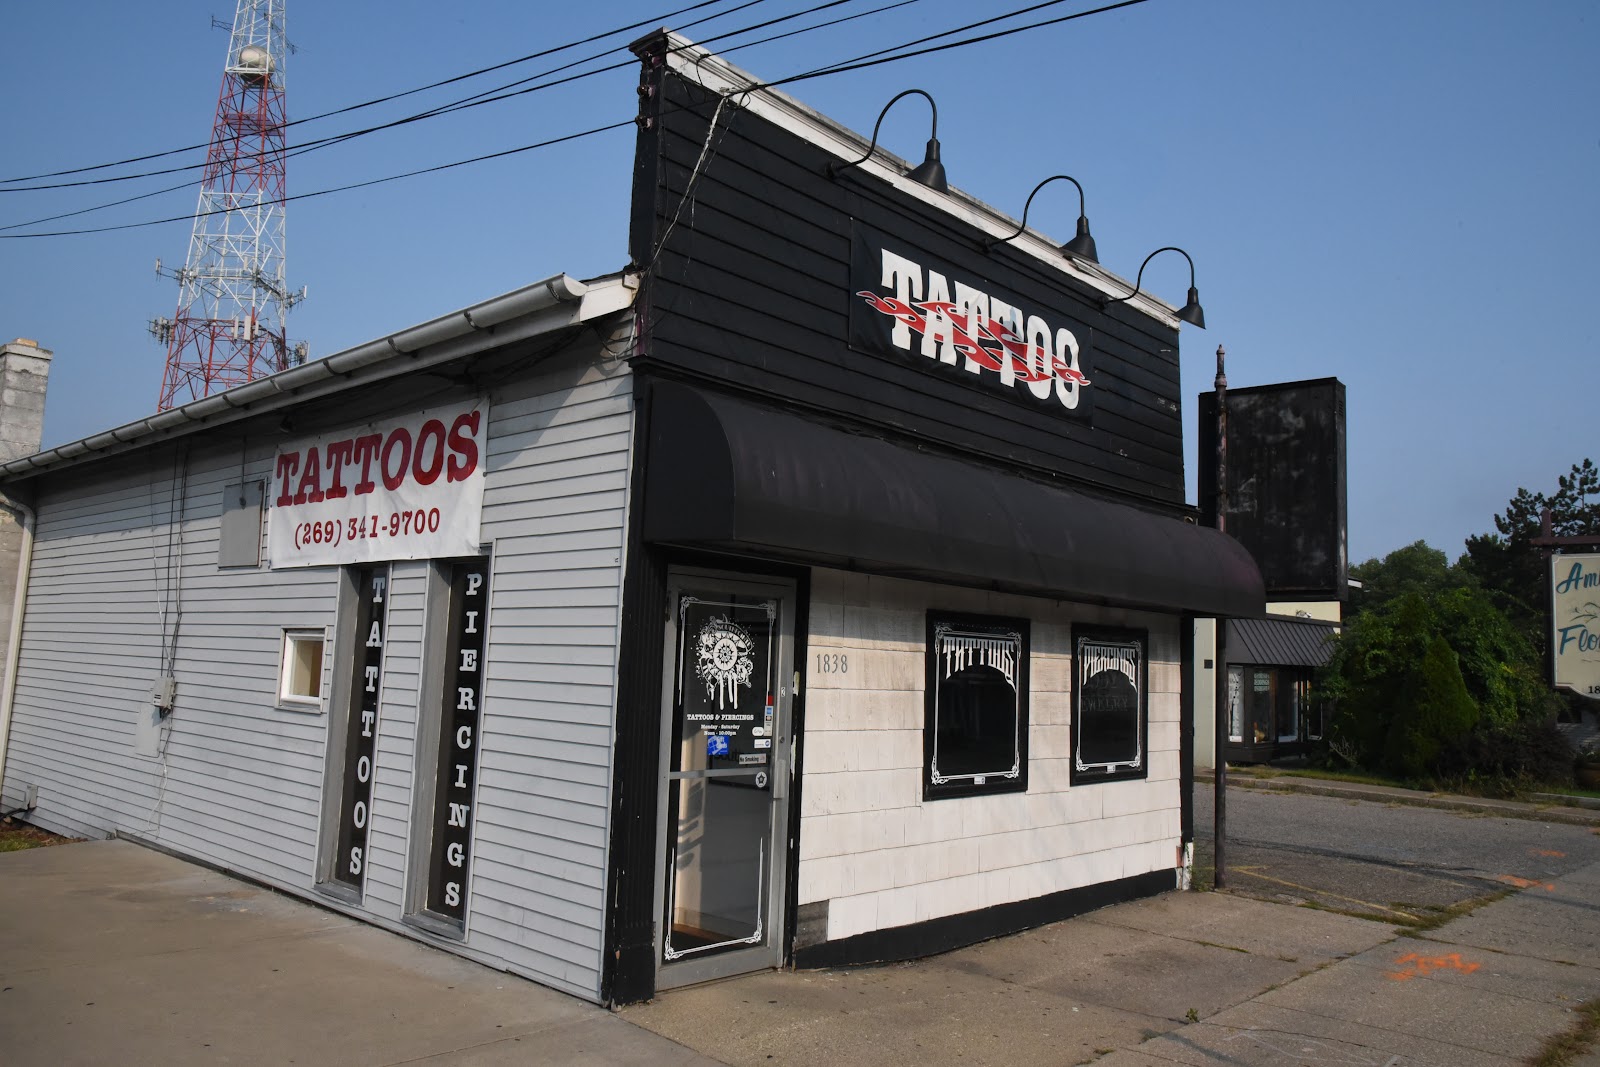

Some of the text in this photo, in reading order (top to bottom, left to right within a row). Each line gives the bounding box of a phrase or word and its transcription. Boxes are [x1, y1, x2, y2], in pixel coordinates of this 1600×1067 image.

[276, 410, 481, 508] TATTOOS
[294, 507, 440, 550] (269) 341-9700
[1556, 562, 1600, 594] Am
[1557, 624, 1600, 655] Flo
[816, 653, 848, 674] 1838
[943, 636, 1017, 692] TATTOOS
[1083, 645, 1137, 693] PIERCINGS
[349, 577, 386, 875] TATTOOS
[445, 572, 482, 907] PIERCINGS
[745, 755, 759, 763] Smoking
